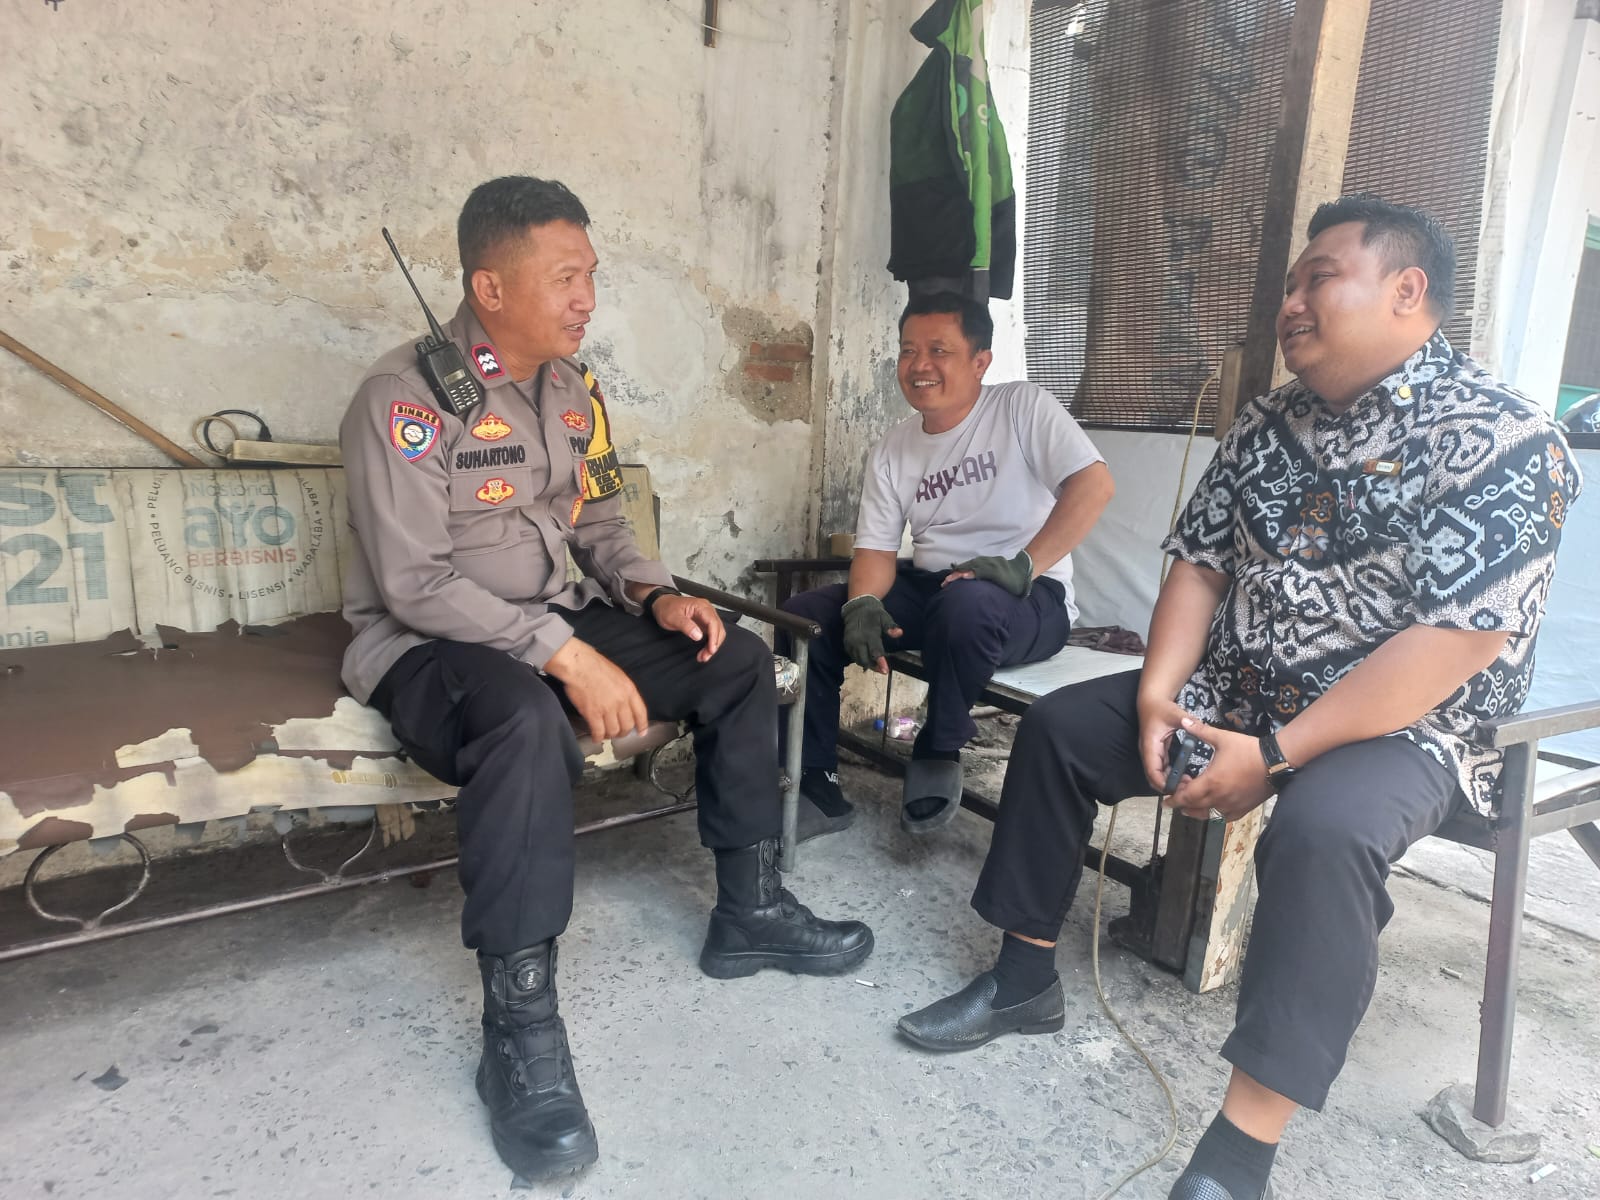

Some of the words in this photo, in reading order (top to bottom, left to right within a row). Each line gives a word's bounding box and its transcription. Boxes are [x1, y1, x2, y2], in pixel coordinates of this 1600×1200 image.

[455, 444, 526, 469] SUHARTONO
[187, 548, 297, 568] BERBISNIS
[293, 518, 324, 577] WARALABA
[0, 533, 109, 606] 21
[183, 574, 225, 598] BISNIS
[238, 580, 286, 600] LISENSI
